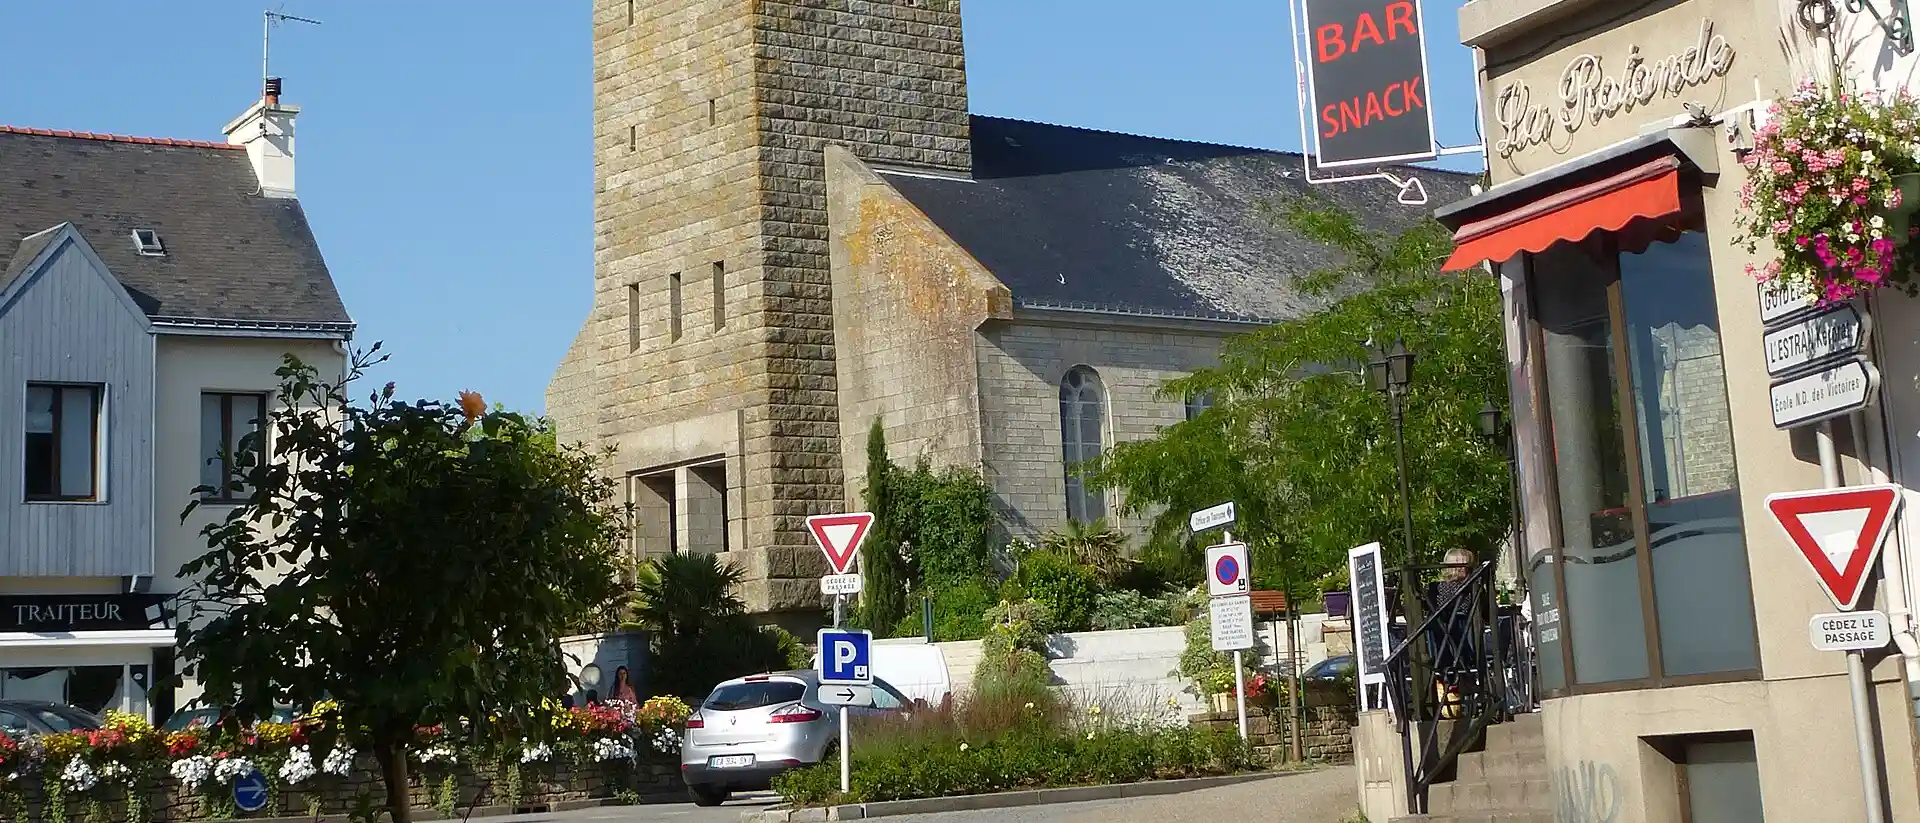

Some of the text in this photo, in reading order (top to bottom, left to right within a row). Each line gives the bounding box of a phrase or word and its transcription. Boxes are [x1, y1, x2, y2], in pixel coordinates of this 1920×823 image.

[1316, 2, 1416, 63] BAR
[1322, 76, 1423, 138] SNACK
[1496, 79, 1554, 159] La
[1770, 328, 1815, 363] L'ESTRAN
[1812, 386, 1824, 402] des
[1827, 376, 1860, 397] Victoires
[13, 600, 124, 625] TRAITEUR
[1822, 618, 1875, 631] CÉDEZ LE
[1825, 631, 1875, 643] PASSAGE
[834, 640, 857, 673] P
